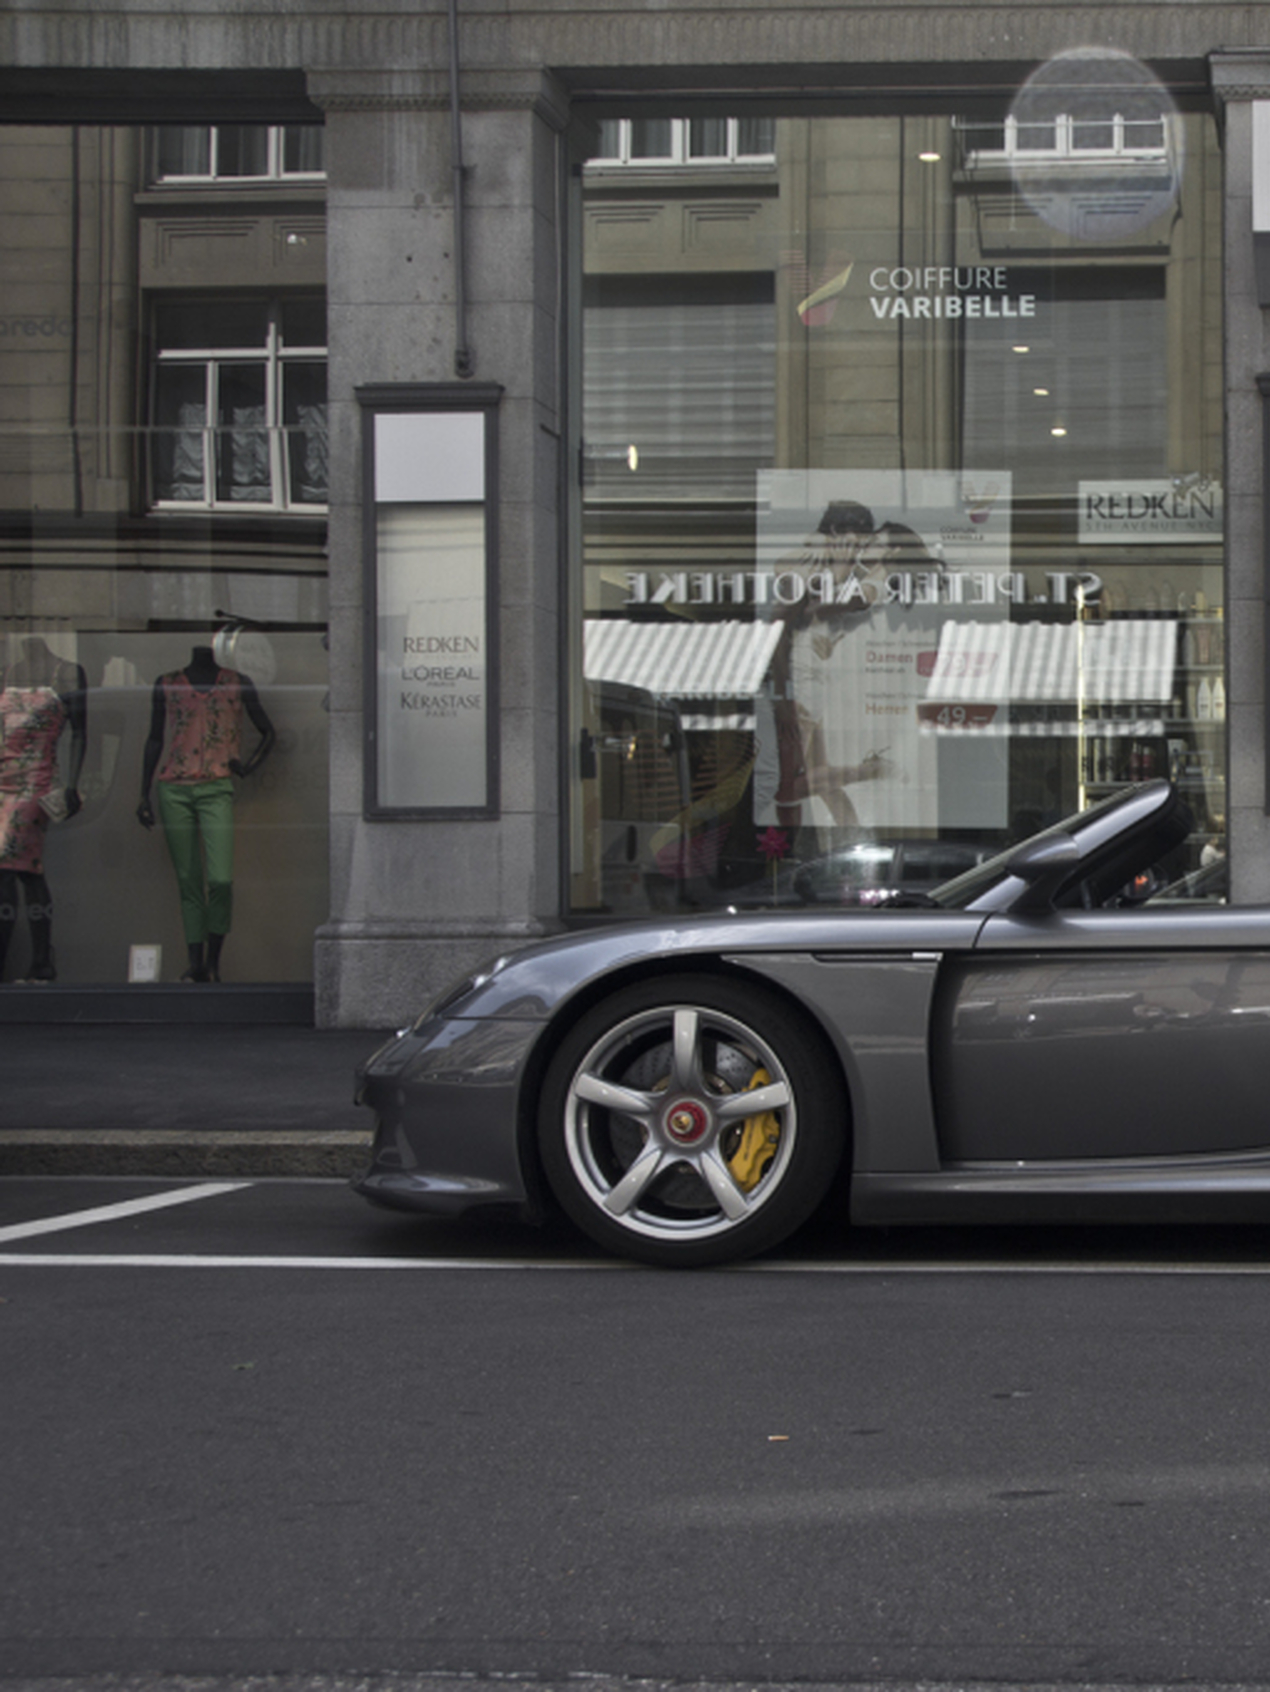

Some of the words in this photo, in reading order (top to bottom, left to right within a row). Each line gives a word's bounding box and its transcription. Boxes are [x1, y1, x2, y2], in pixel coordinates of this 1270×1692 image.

[870, 267, 1007, 291] COIFFURE
[870, 295, 1036, 319] VARIBELLE
[1086, 493, 1214, 519] REDKEN
[1122, 521, 1177, 531] AVENUE
[403, 636, 480, 654] REDKEN
